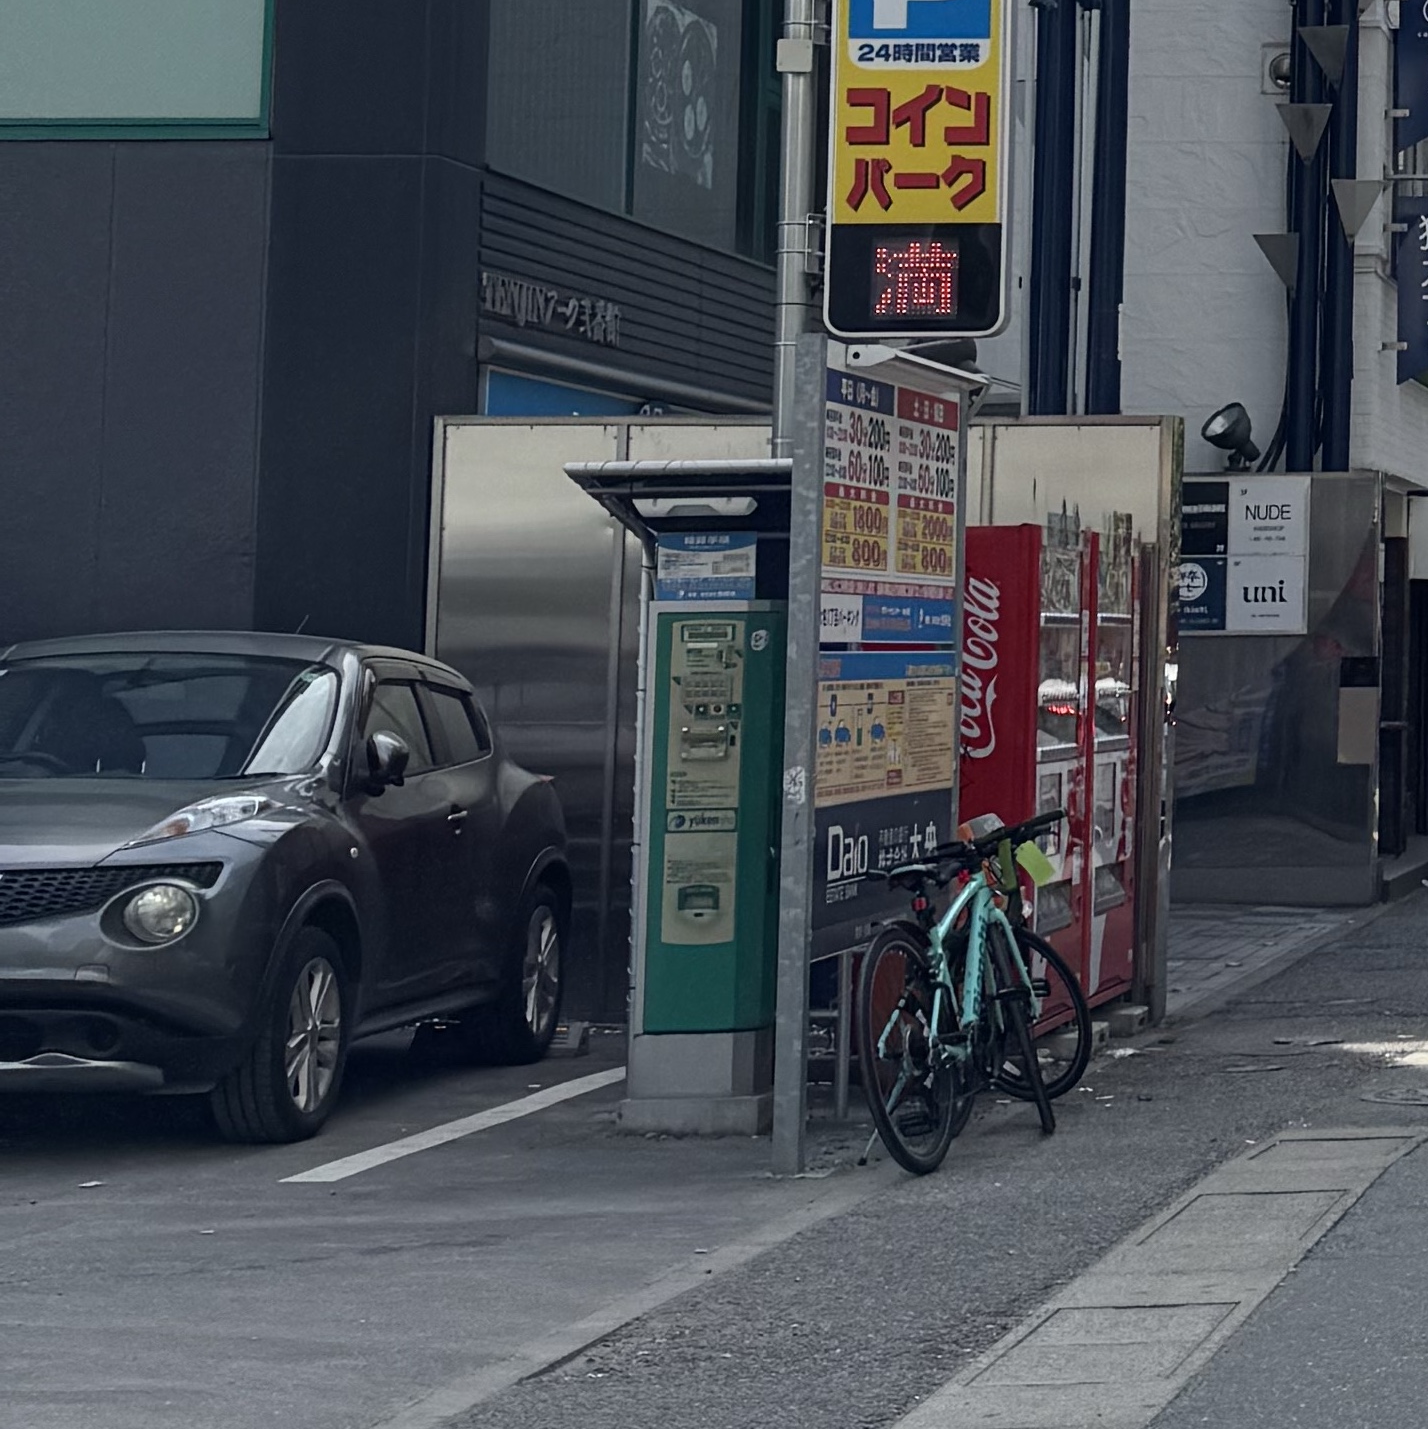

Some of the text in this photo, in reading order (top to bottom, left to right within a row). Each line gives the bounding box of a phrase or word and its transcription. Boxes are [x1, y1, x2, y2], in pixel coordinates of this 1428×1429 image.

[857, 42, 981, 63] 24時間営業
[846, 84, 991, 147] コイン
[846, 154, 987, 212] パーク
[875, 242, 957, 314] 満
[1244, 503, 1292, 521] NUDE
[1242, 579, 1288, 604] uni
[826, 823, 869, 882] Daio
